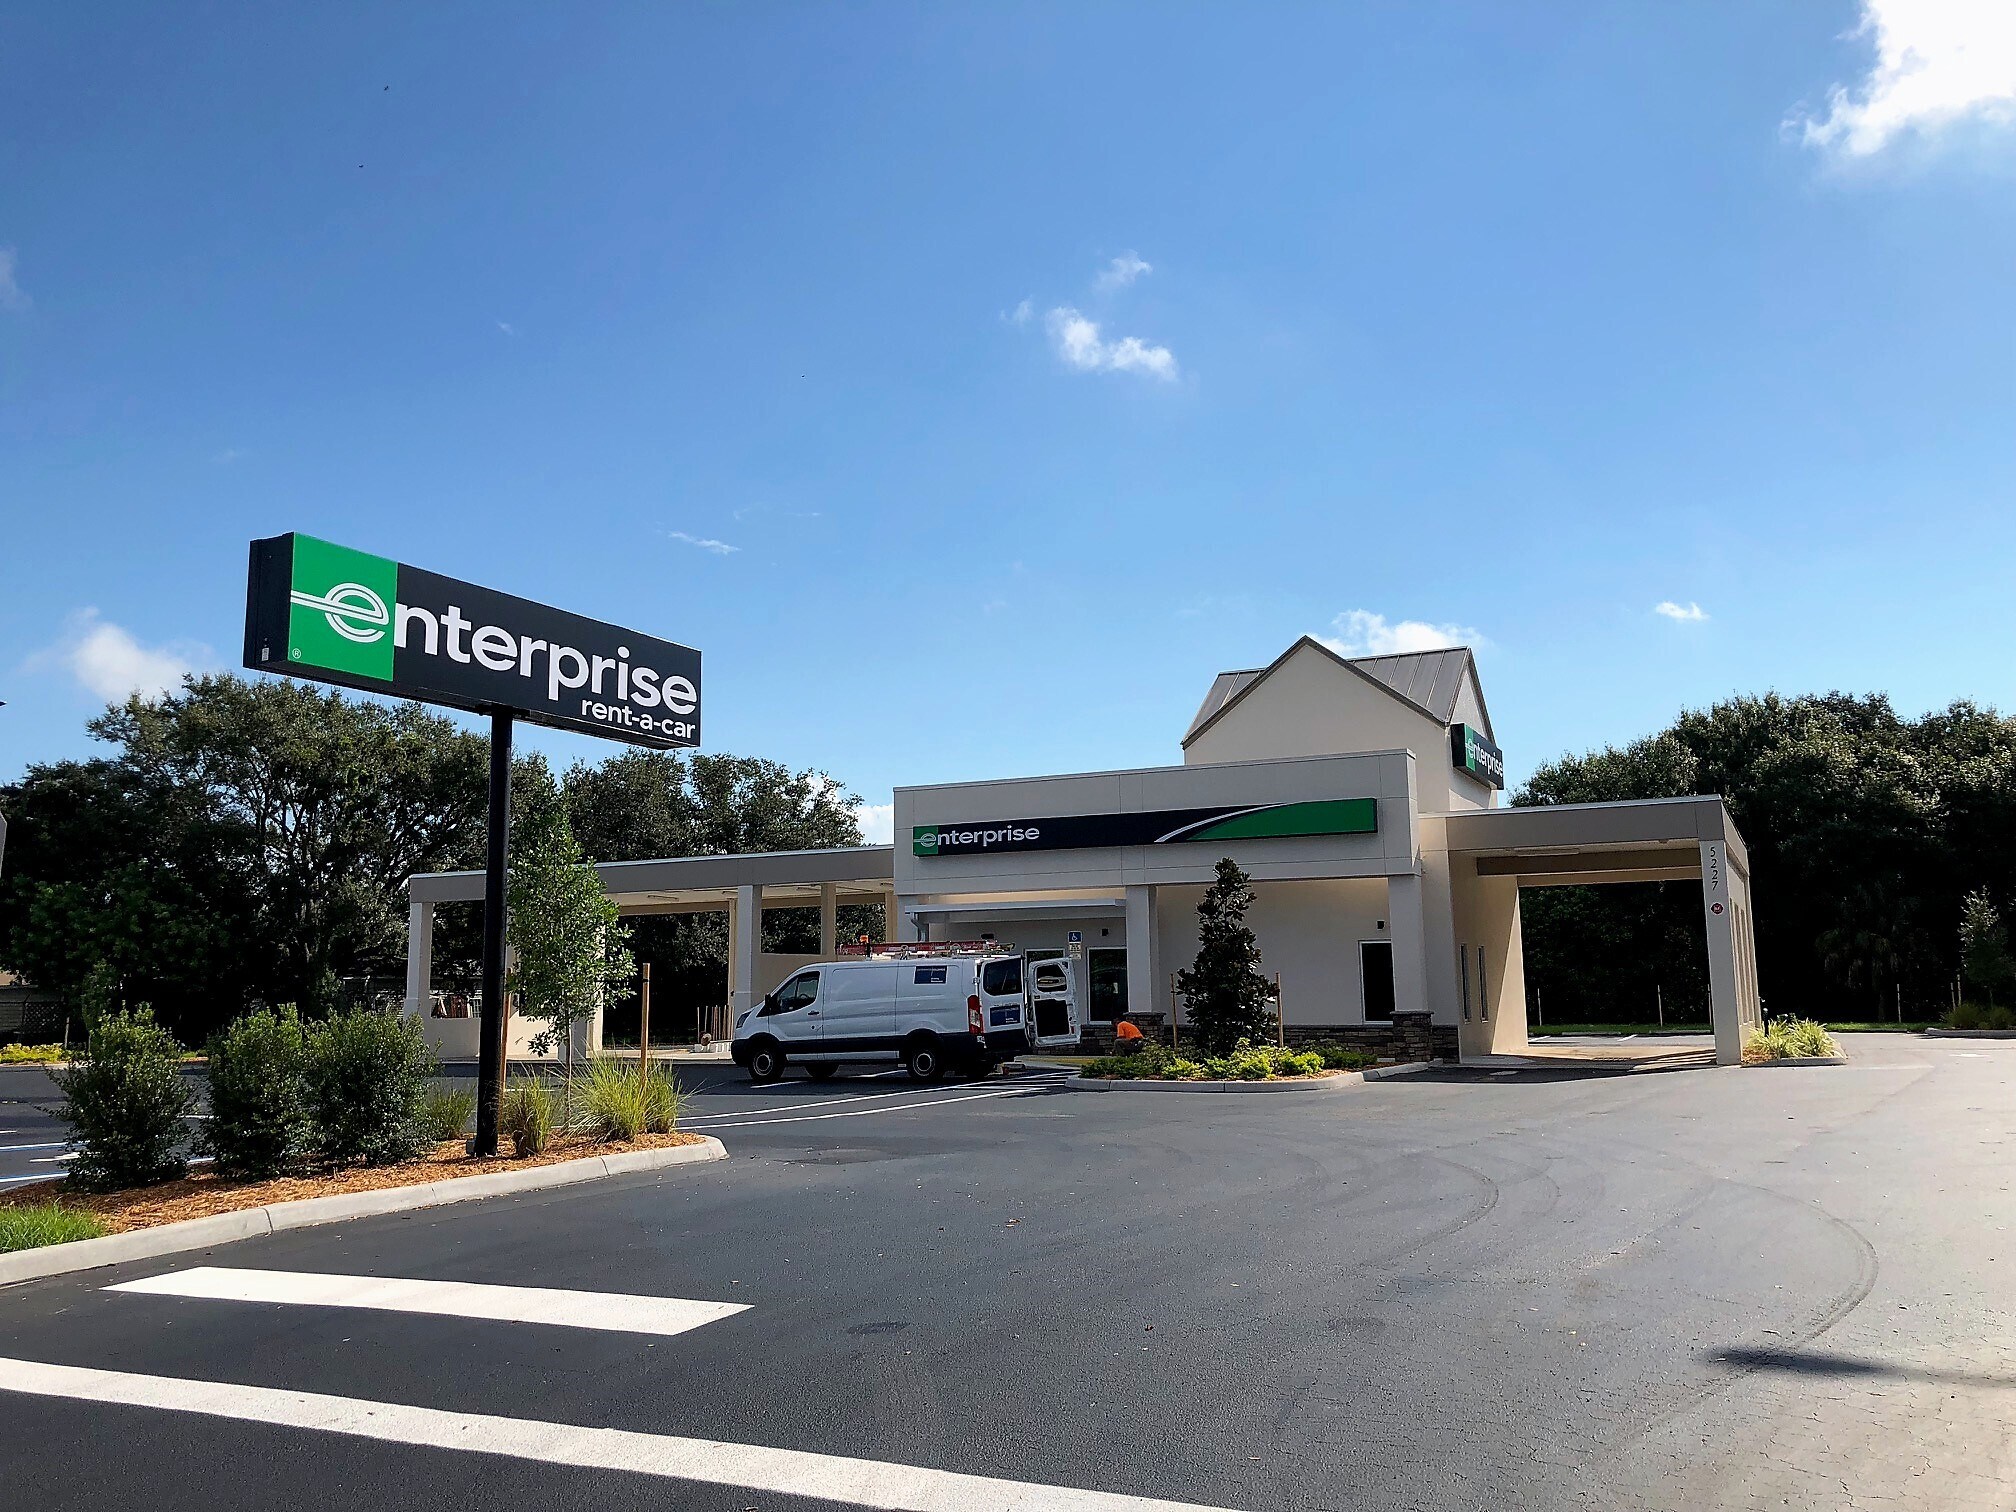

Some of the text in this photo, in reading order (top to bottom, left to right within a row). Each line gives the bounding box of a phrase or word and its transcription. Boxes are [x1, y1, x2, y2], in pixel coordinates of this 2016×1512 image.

[291, 582, 698, 714] enterprise
[581, 699, 696, 739] rent-a-car
[1465, 738, 1504, 778] enterprise
[914, 824, 1040, 848] enterprise
[1709, 846, 1719, 891] 5227
